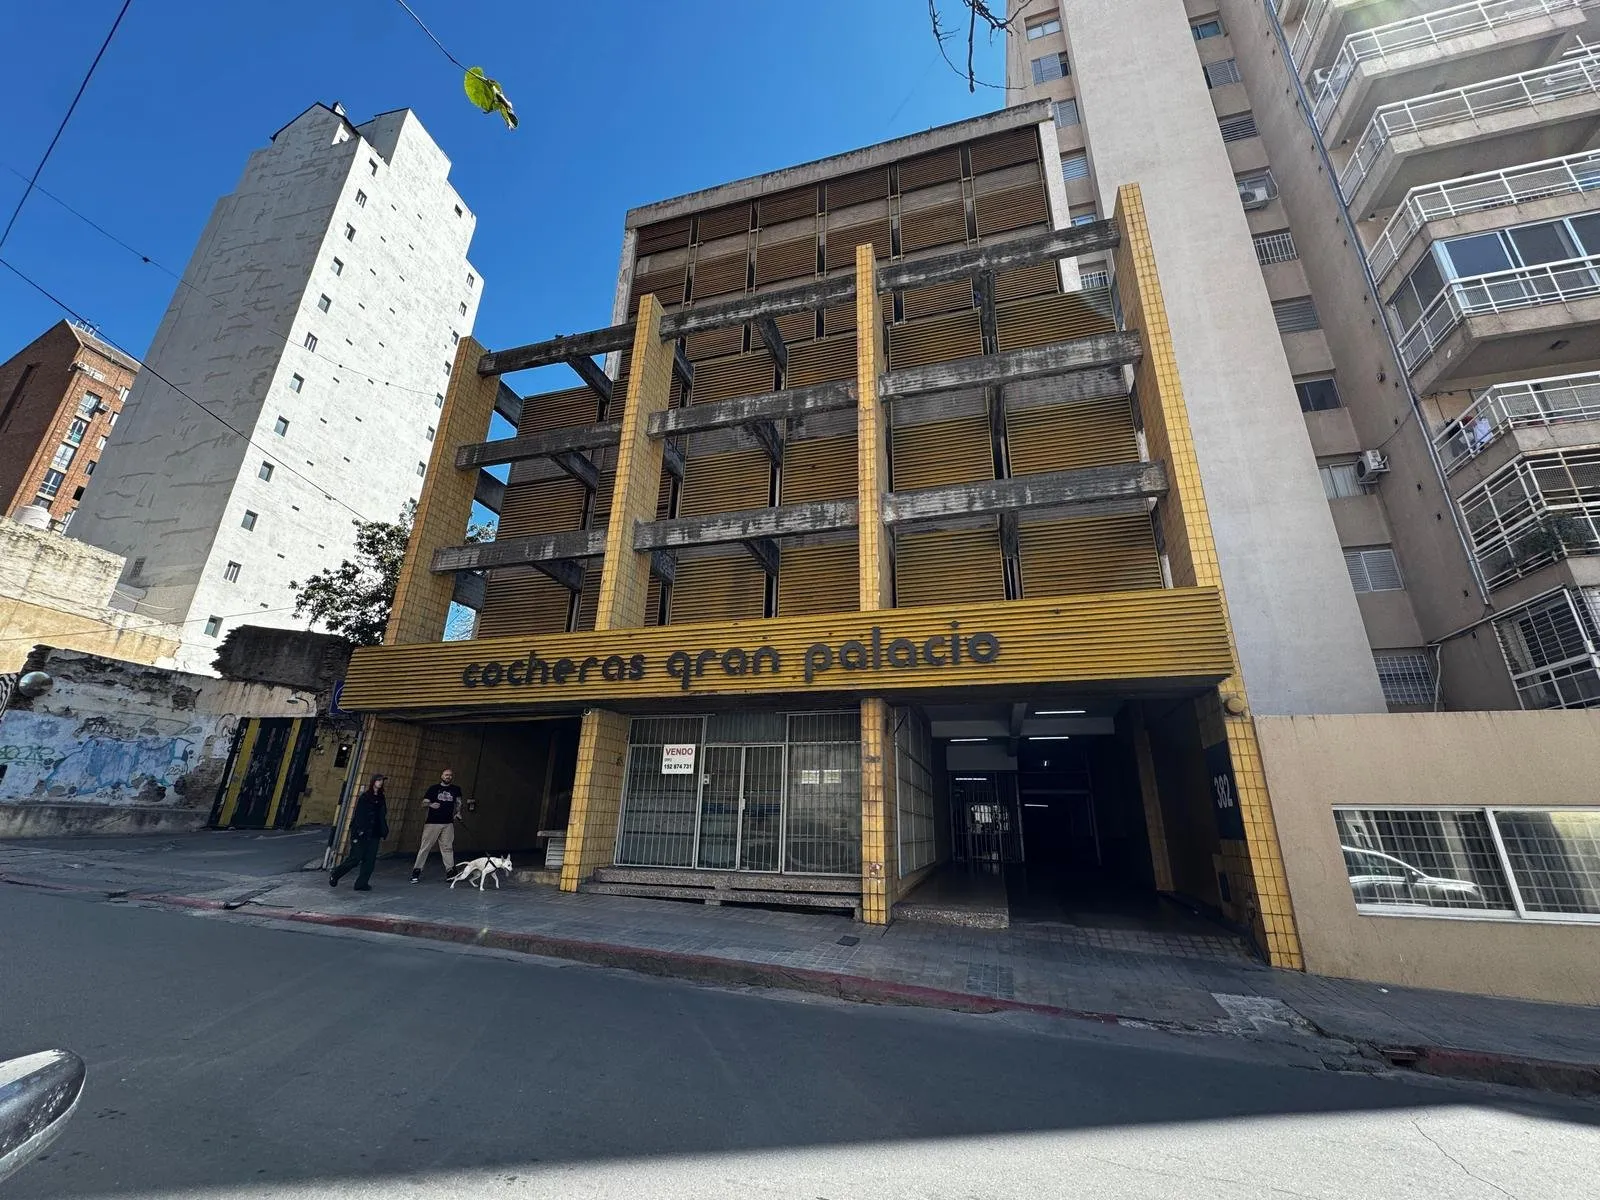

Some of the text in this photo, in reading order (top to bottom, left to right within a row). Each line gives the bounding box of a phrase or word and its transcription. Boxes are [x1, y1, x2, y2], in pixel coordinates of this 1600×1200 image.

[462, 649, 646, 688] cocheras
[804, 620, 1001, 684] palacio
[666, 748, 693, 756] VENDO
[1214, 774, 1233, 808] 382
